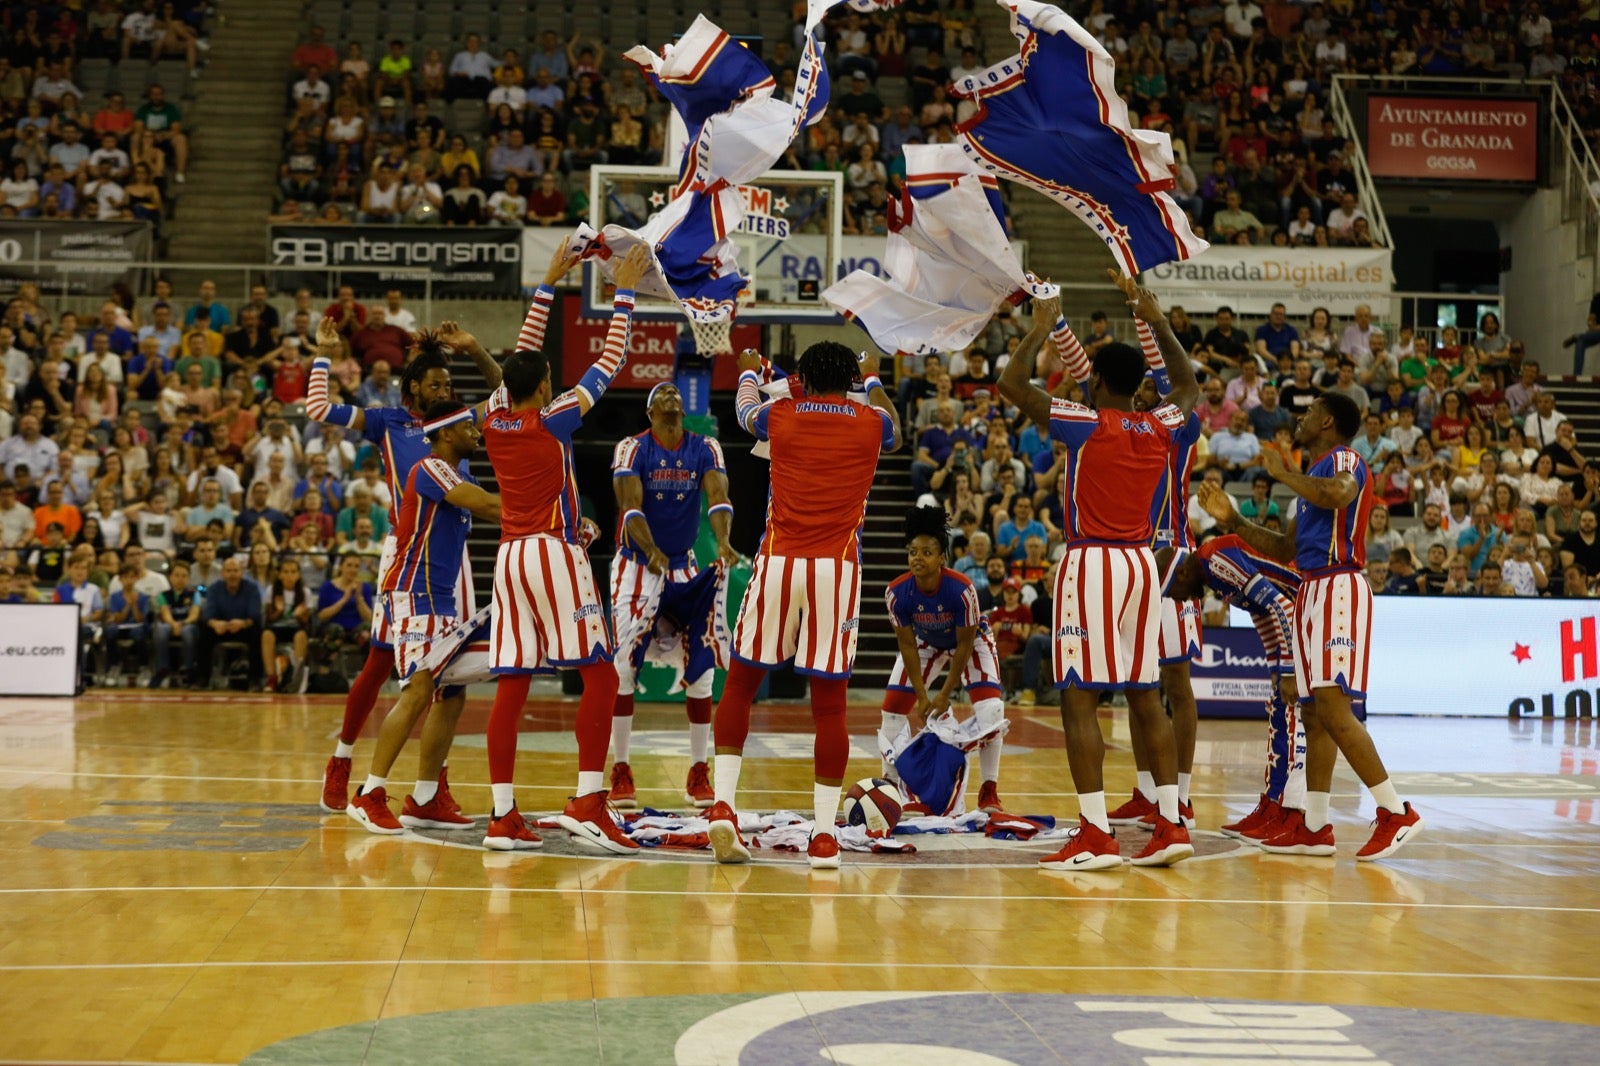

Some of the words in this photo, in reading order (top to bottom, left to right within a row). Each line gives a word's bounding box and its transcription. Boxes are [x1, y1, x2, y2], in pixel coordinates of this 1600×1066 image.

[1379, 102, 1528, 127] AYUNTAMIENTO
[1421, 127, 1515, 151] GRANADA
[333, 237, 520, 266] interiorismo
[1153, 260, 1383, 288] GranadaDigital.es
[796, 402, 856, 417] THUNDER
[1057, 625, 1088, 641] HARLEM
[1212, 682, 1242, 690] OFFICIAL
